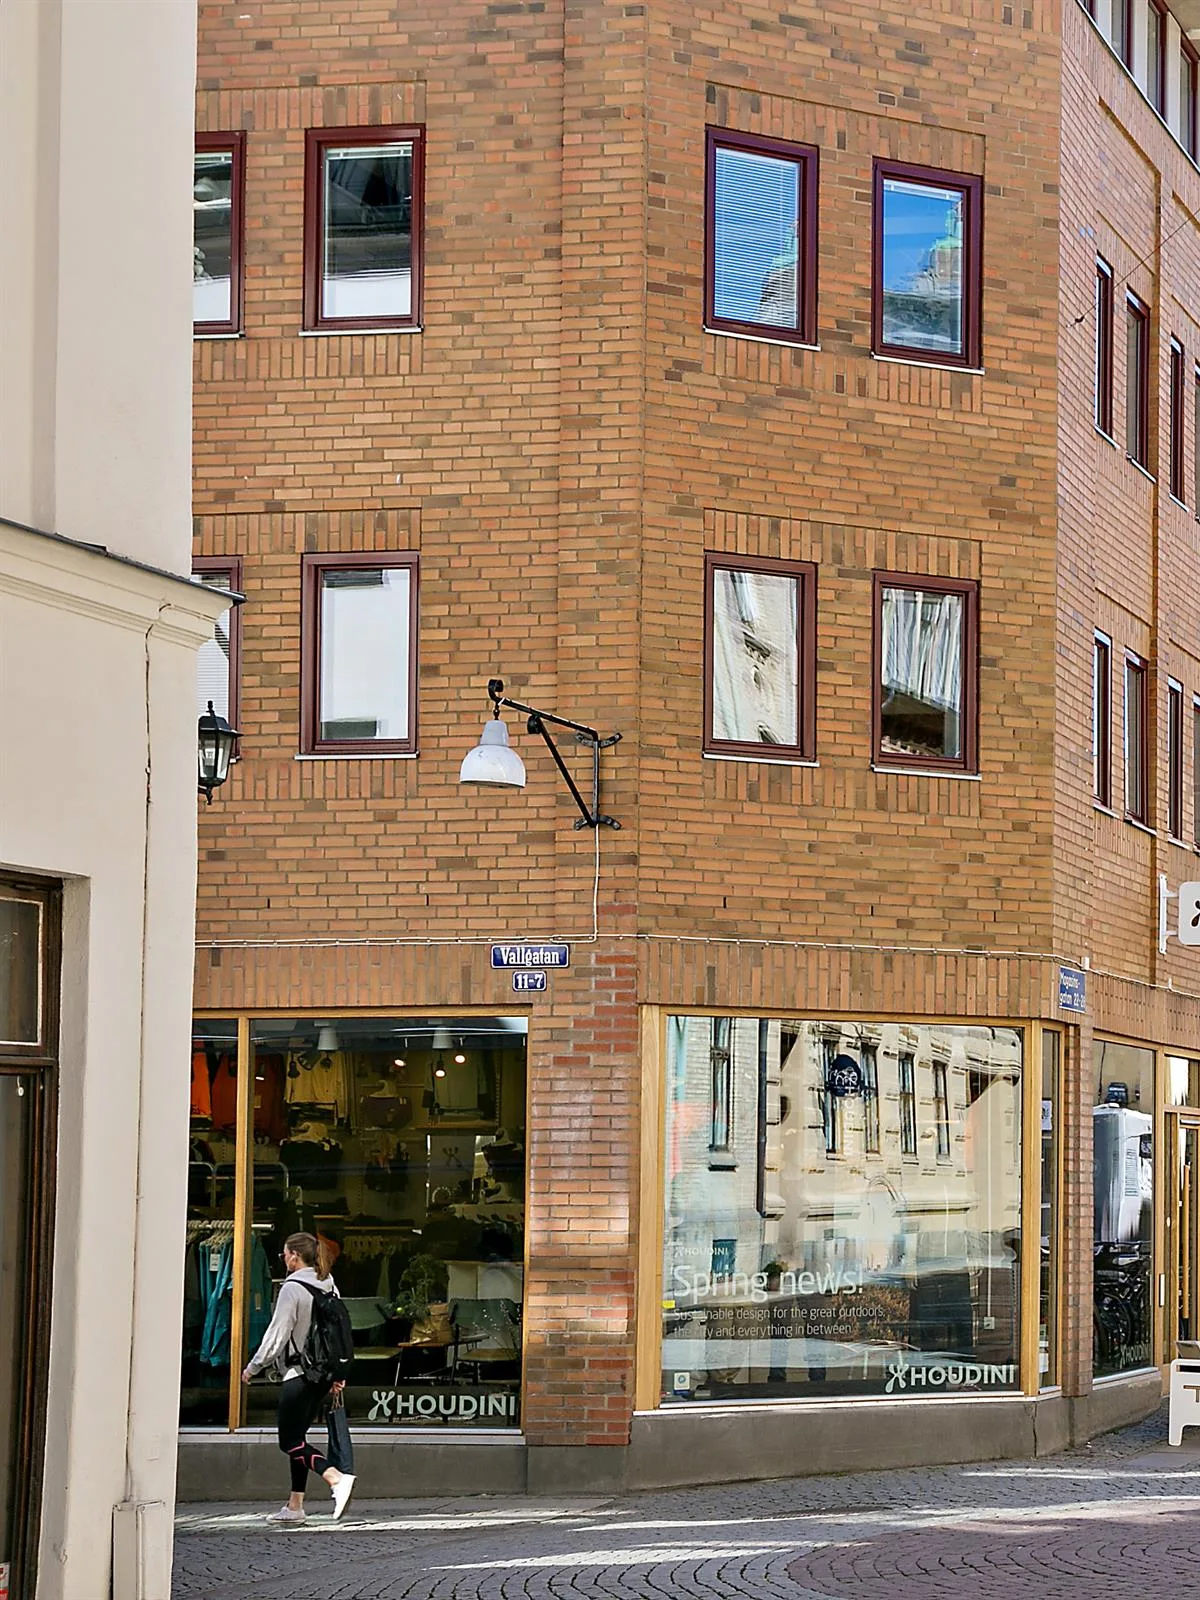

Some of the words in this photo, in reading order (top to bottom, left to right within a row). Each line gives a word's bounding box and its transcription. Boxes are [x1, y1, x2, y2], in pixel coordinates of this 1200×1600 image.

[500, 947, 560, 967] Vallgatan
[516, 973, 543, 989] 11-7
[685, 1247, 728, 1256] HOUDINI
[673, 1264, 769, 1304] Spring
[780, 1266, 863, 1295] news!
[673, 1308, 734, 1321] Susinable
[736, 1308, 770, 1322] design
[773, 1306, 788, 1319] for
[791, 1307, 808, 1318] the
[810, 1307, 837, 1321] great
[838, 1306, 886, 1319] outdoors,
[715, 1325, 736, 1337] and
[737, 1324, 793, 1338] everything
[795, 1324, 804, 1336] in
[806, 1324, 852, 1335] between
[910, 1364, 1014, 1386] HOUDINI
[396, 1394, 516, 1416] HOUDINI
